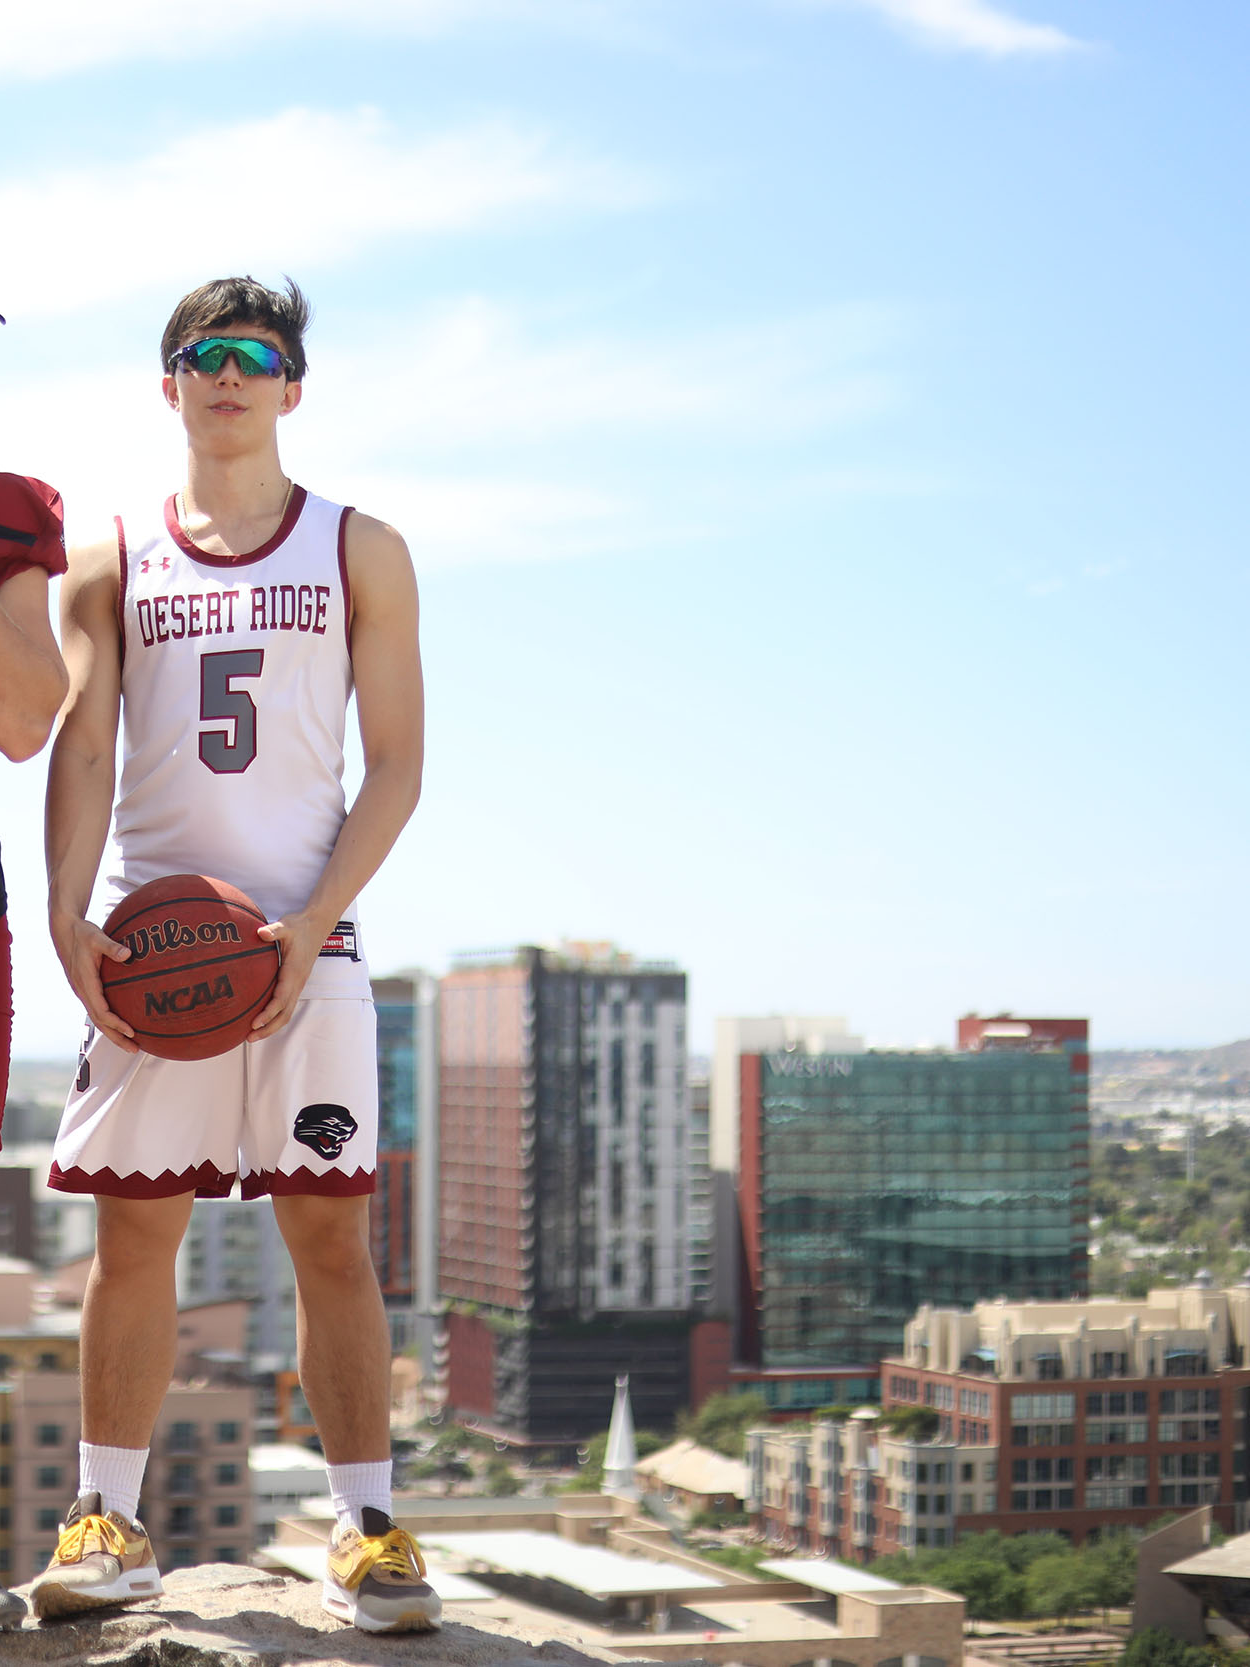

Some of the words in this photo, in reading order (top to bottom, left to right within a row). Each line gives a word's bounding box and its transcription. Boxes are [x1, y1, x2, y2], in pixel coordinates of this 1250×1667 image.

[136, 590, 239, 648] DESERT
[250, 584, 330, 635] RIDGE
[199, 648, 265, 774] 5
[118, 918, 242, 967] Wilson
[144, 973, 235, 1017] NCAA
